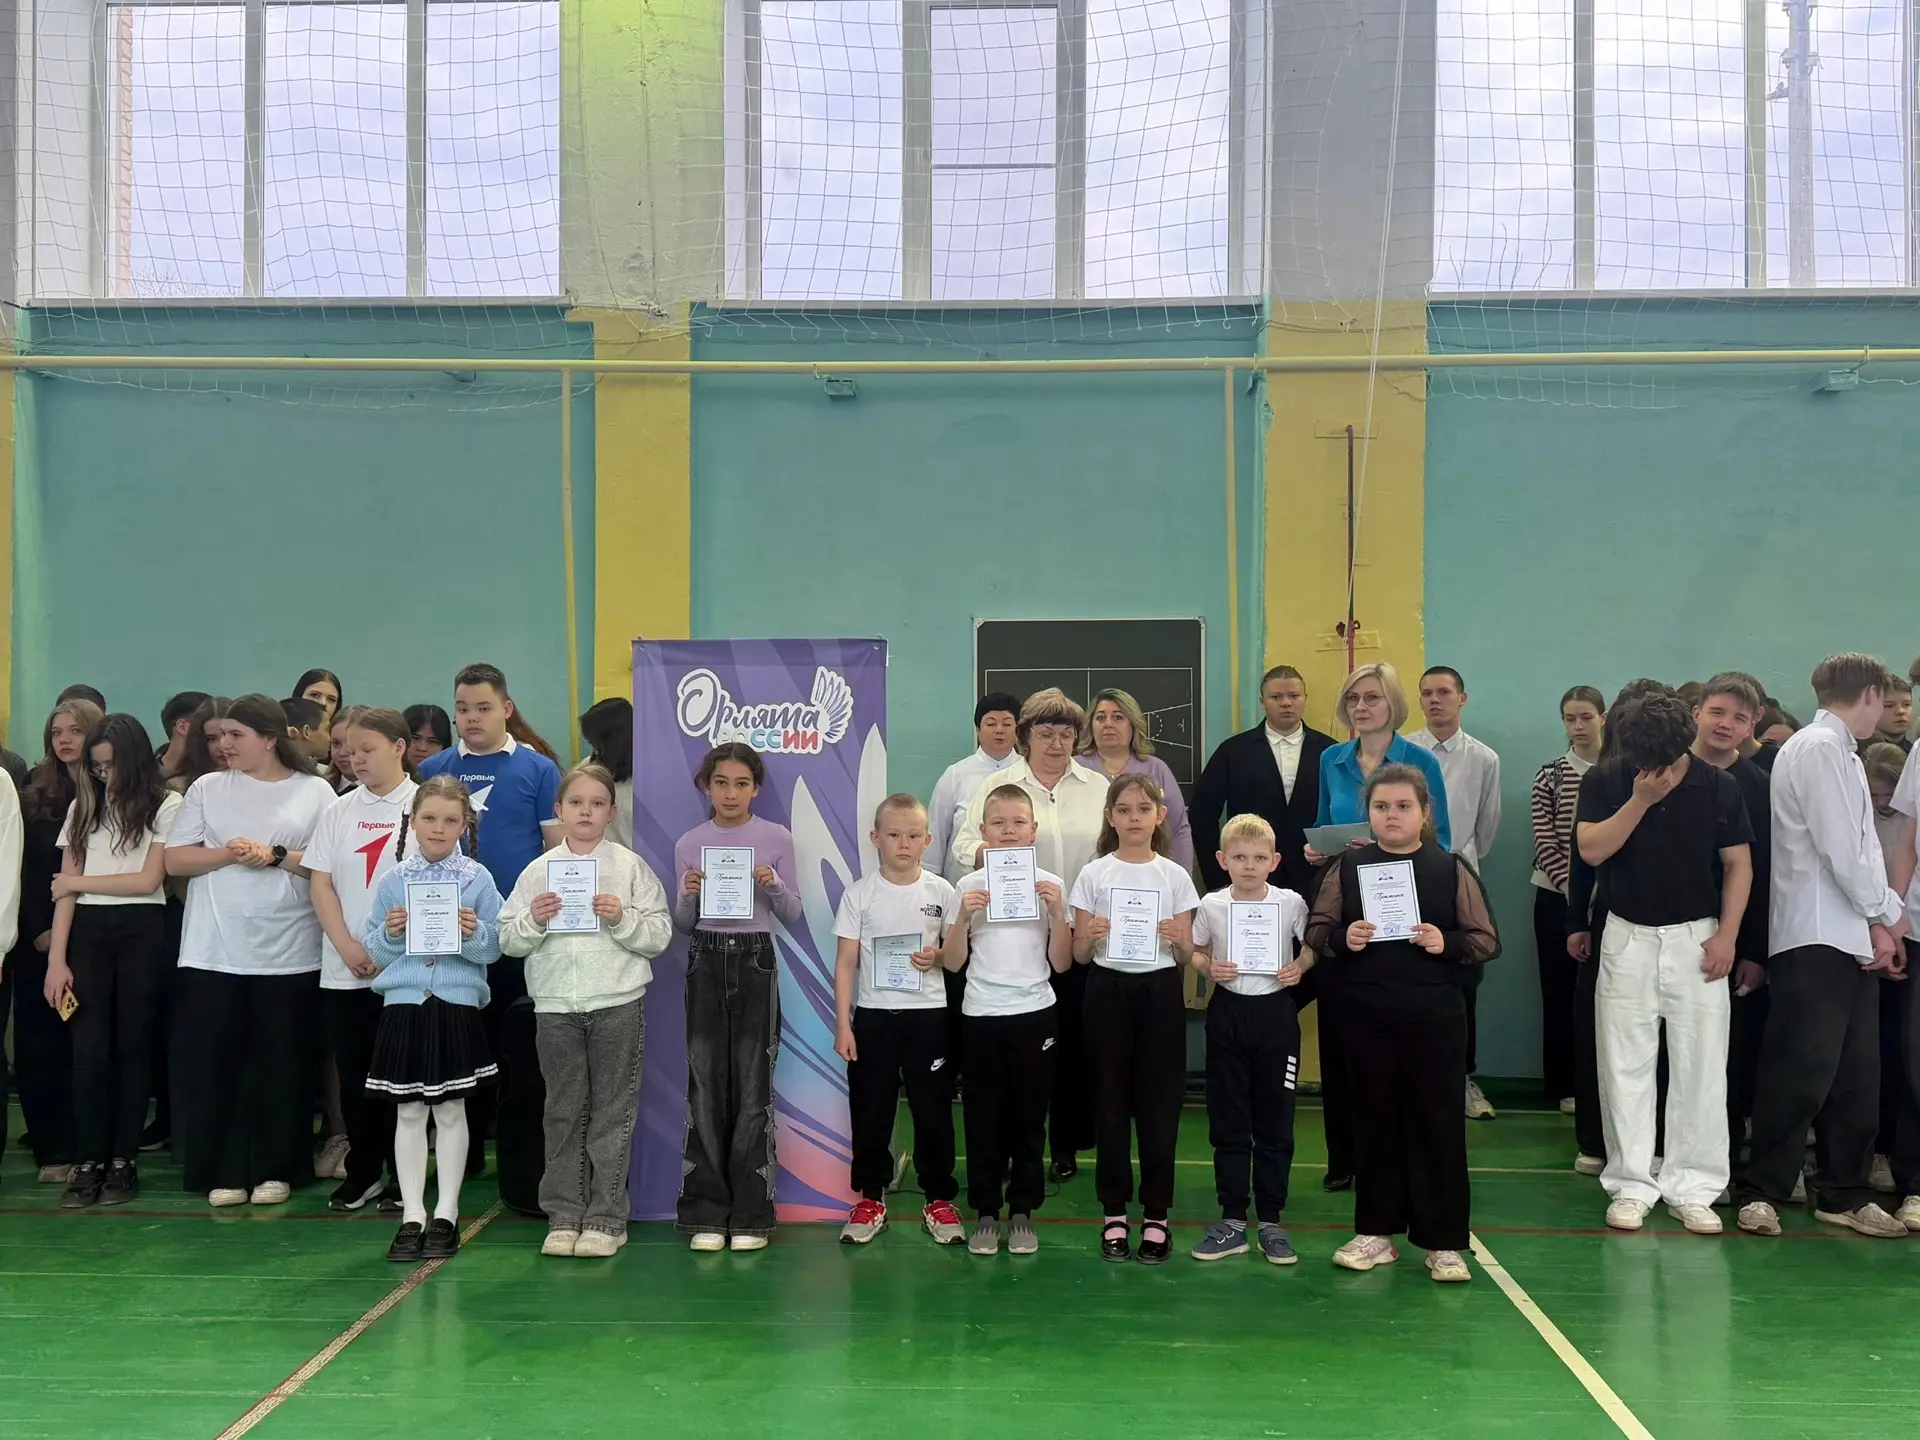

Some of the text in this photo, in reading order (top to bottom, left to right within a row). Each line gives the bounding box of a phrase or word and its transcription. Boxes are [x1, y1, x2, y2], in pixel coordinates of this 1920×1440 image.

[681, 672, 821, 739] Орлята
[459, 774, 496, 782] Первые
[357, 821, 396, 831] Первые
